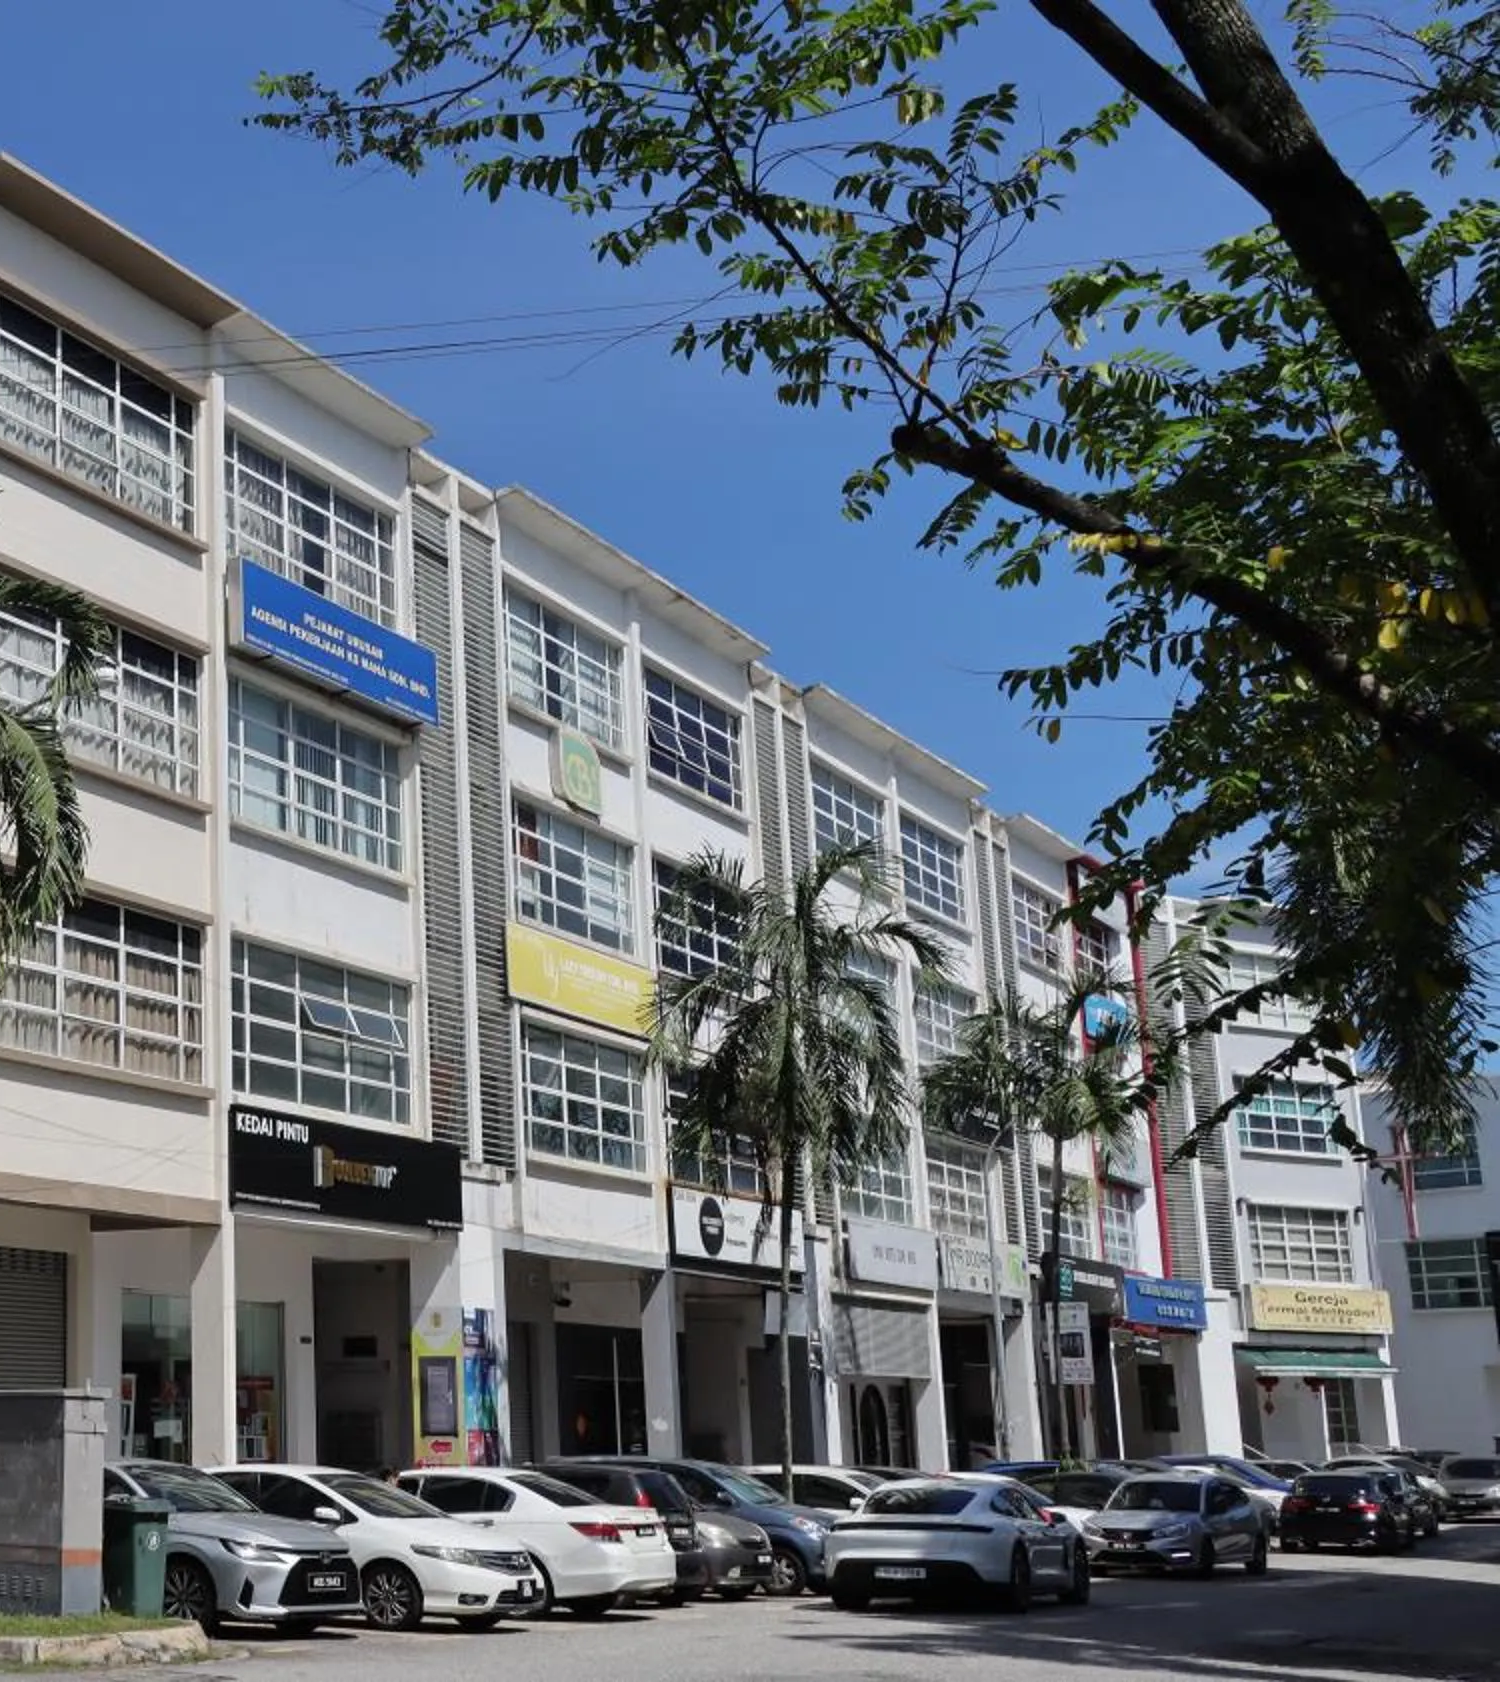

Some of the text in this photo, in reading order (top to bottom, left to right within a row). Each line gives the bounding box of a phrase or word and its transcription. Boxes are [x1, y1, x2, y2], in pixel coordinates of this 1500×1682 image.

[235, 1111, 309, 1144] KEDAI PINTU
[1294, 1291, 1349, 1307] Gereja
[1311, 1306, 1376, 1318] Methodist
